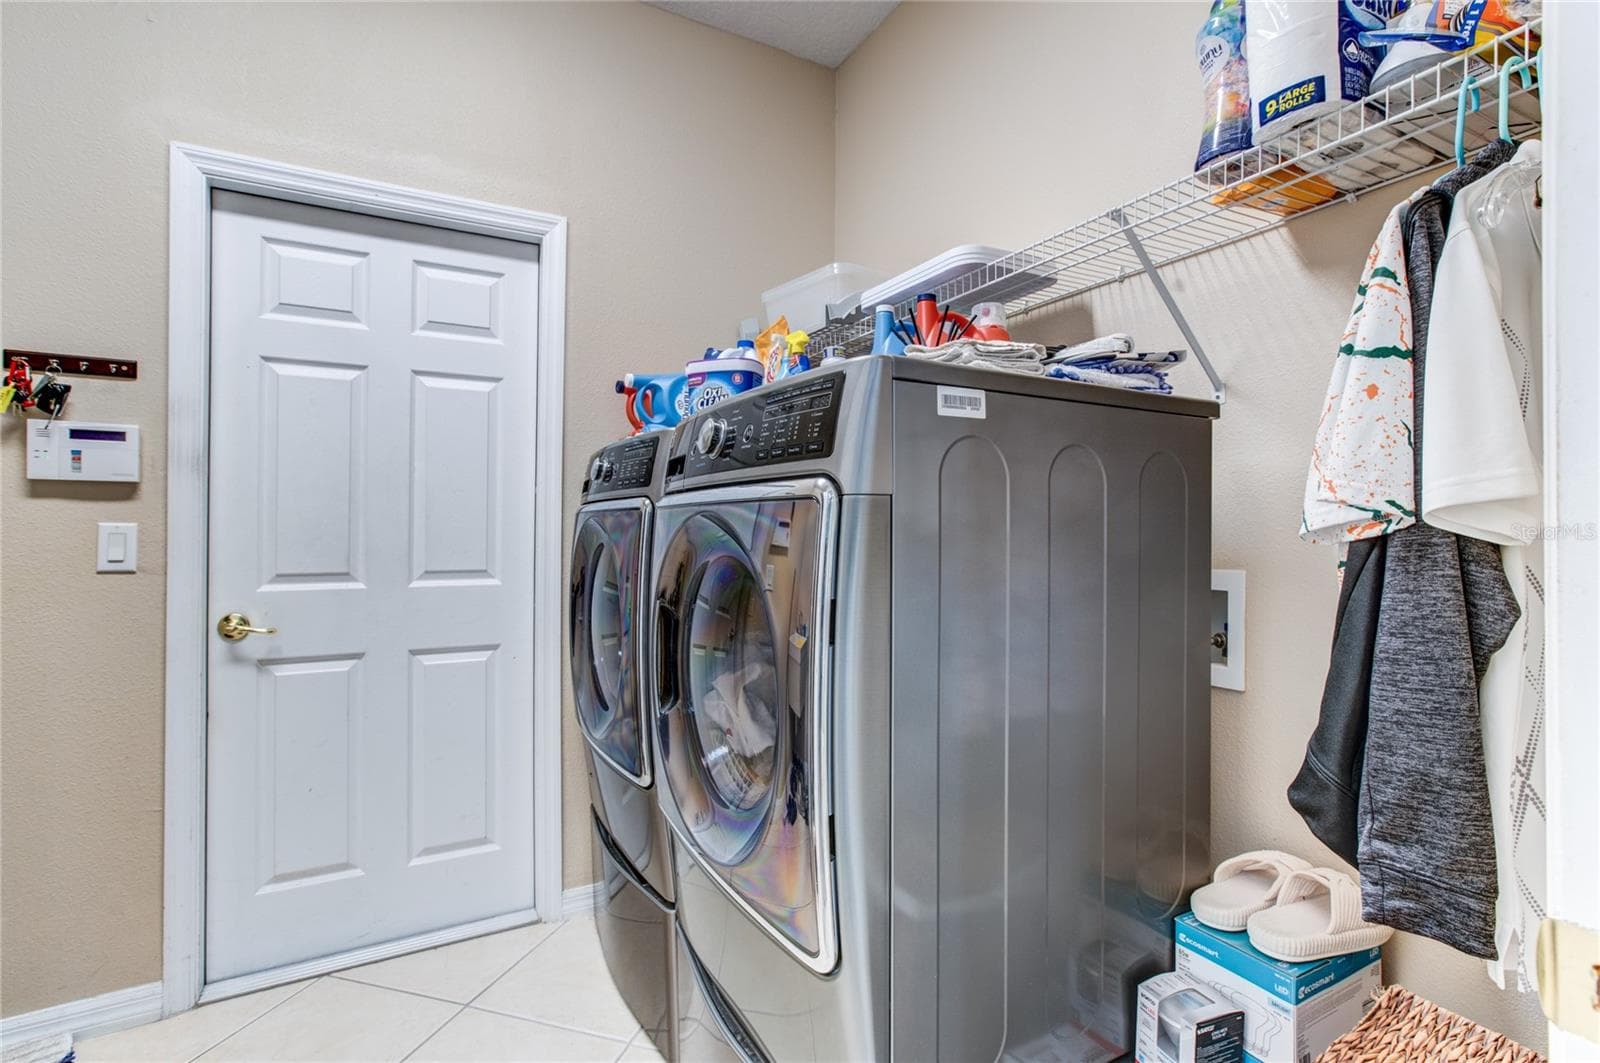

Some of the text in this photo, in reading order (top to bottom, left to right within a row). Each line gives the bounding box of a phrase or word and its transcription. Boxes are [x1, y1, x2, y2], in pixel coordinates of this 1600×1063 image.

[1279, 82, 1315, 103] LARGE
[1265, 100, 1277, 117] 9
[1279, 94, 1312, 112] ROLLS
[704, 387, 722, 399] OXI
[1184, 937, 1219, 958] ecosmart
[1274, 984, 1289, 995] LED
[1304, 973, 1335, 994] ecosmart
